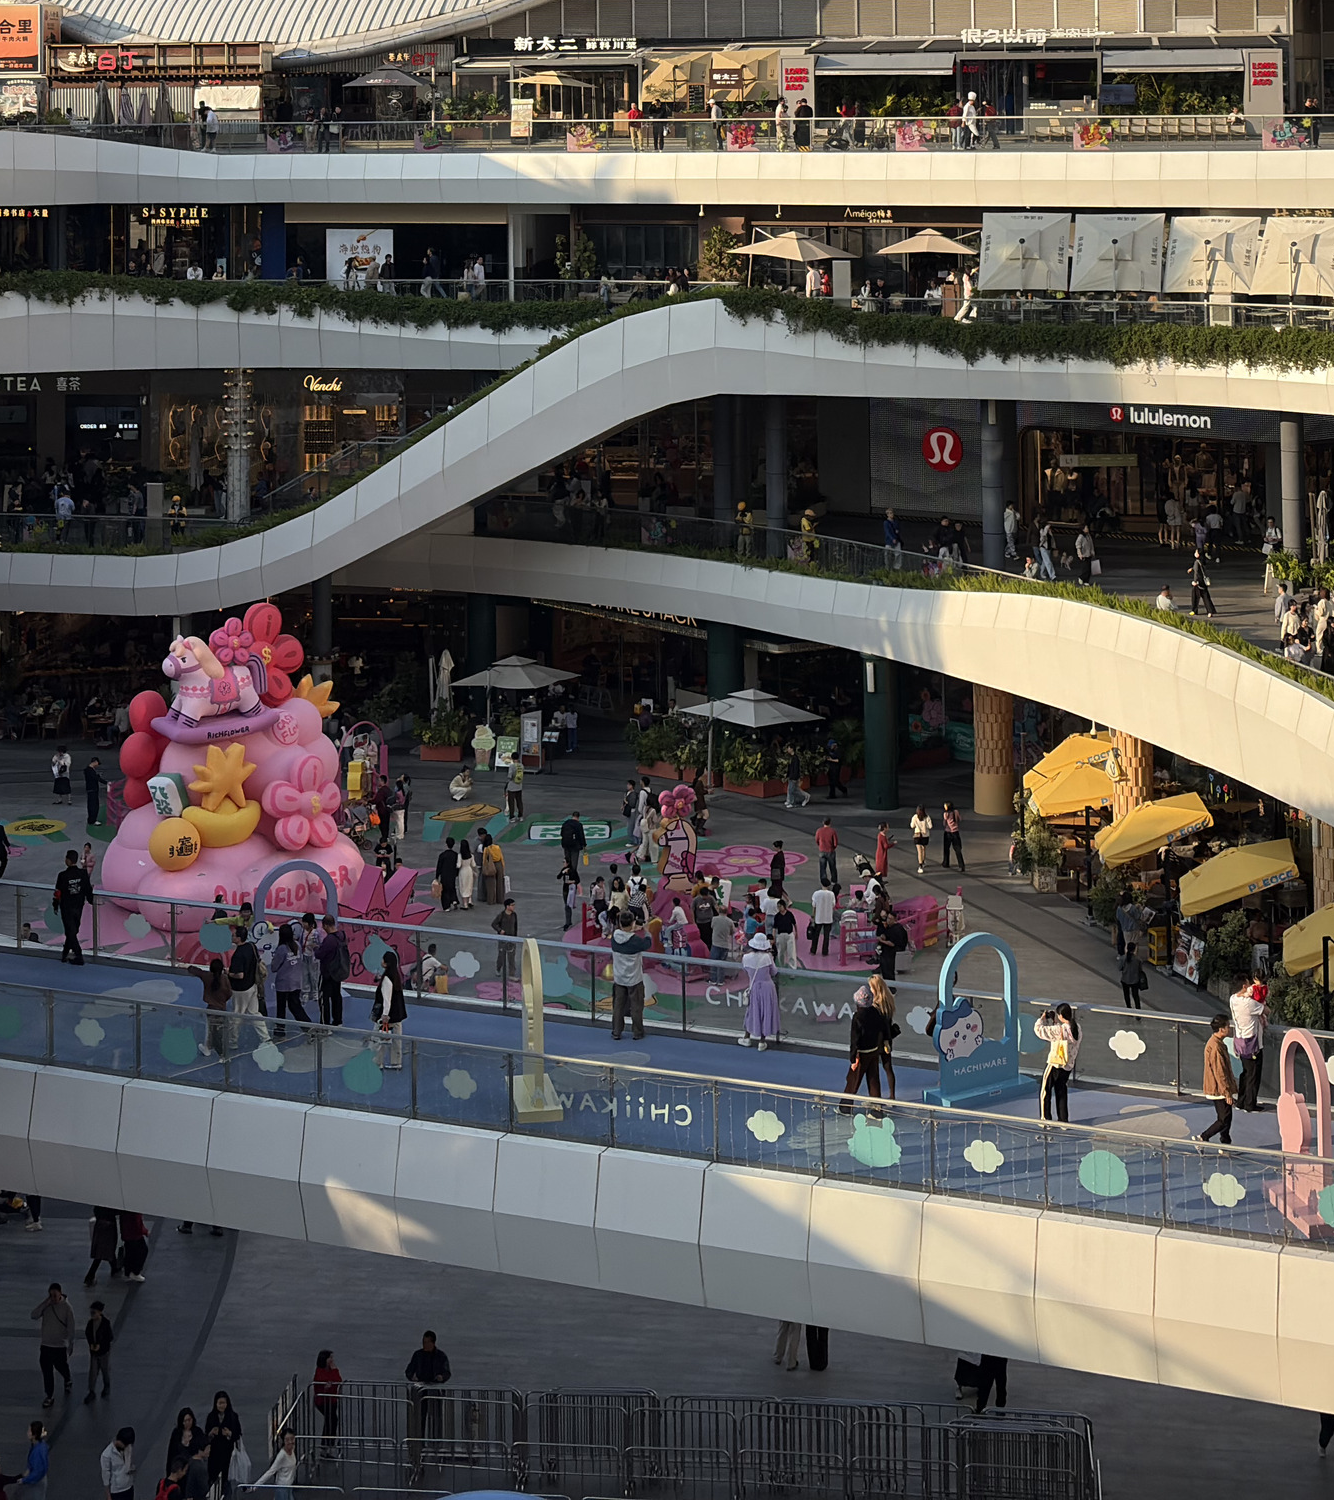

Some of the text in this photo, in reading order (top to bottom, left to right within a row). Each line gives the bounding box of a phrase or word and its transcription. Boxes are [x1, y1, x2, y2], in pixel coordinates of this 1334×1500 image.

[514, 36, 578, 51] 新太二
[961, 28, 1047, 47] 很久以前
[56, 376, 81, 391] 喜茶
[303, 374, 343, 391] Venchi
[1130, 408, 1211, 430] lululemon
[207, 725, 250, 740] RICHFLOWER
[953, 1056, 1008, 1076] HACHIWARE
